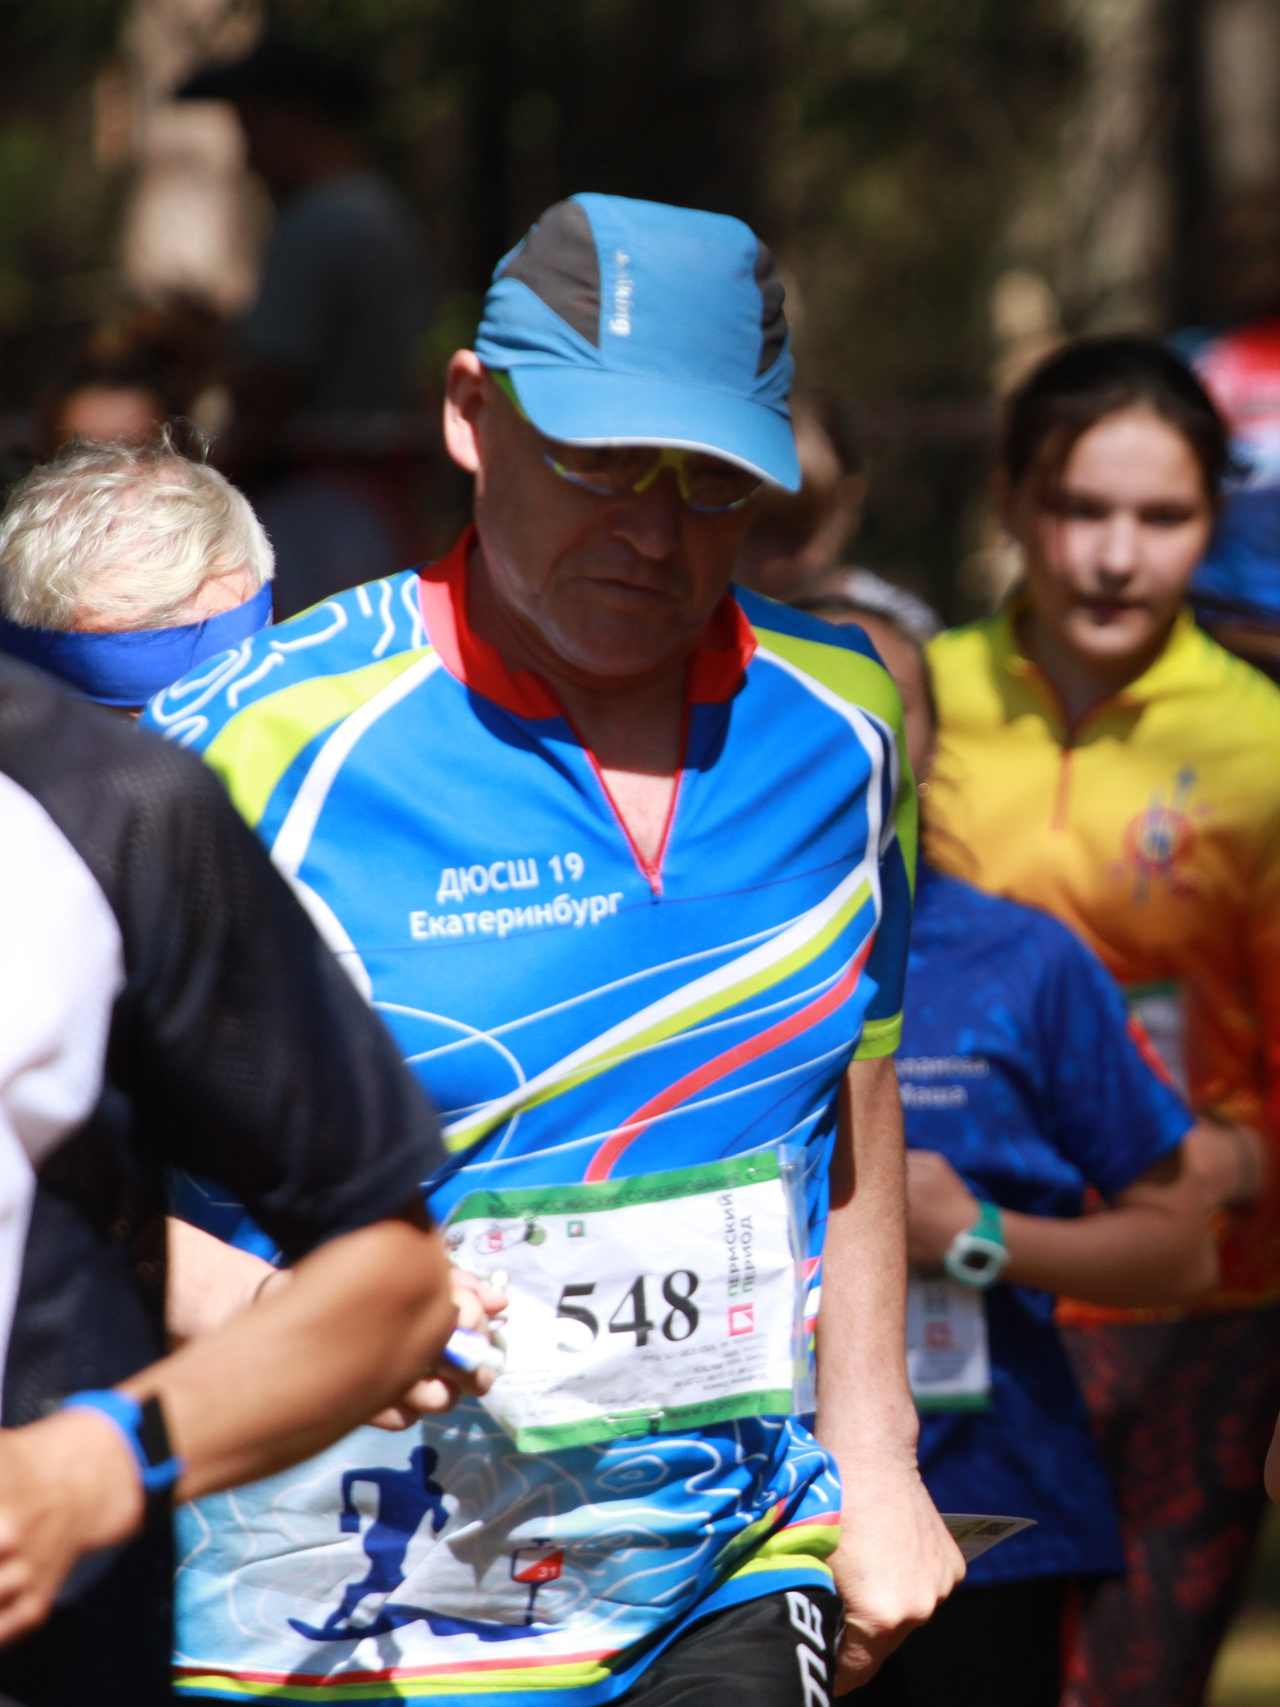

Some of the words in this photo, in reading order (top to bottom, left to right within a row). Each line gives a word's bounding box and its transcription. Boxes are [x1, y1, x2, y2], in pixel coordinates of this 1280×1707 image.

[436, 857, 540, 904] ДЮСШ
[548, 852, 585, 883] 19
[409, 892, 624, 940] Екатеринбург
[718, 1193, 741, 1297] ПЕРМСКИЙ
[741, 1214, 758, 1295] ПЕРИОД
[556, 1270, 699, 1352] 548
[539, 1566, 557, 1578] 31
